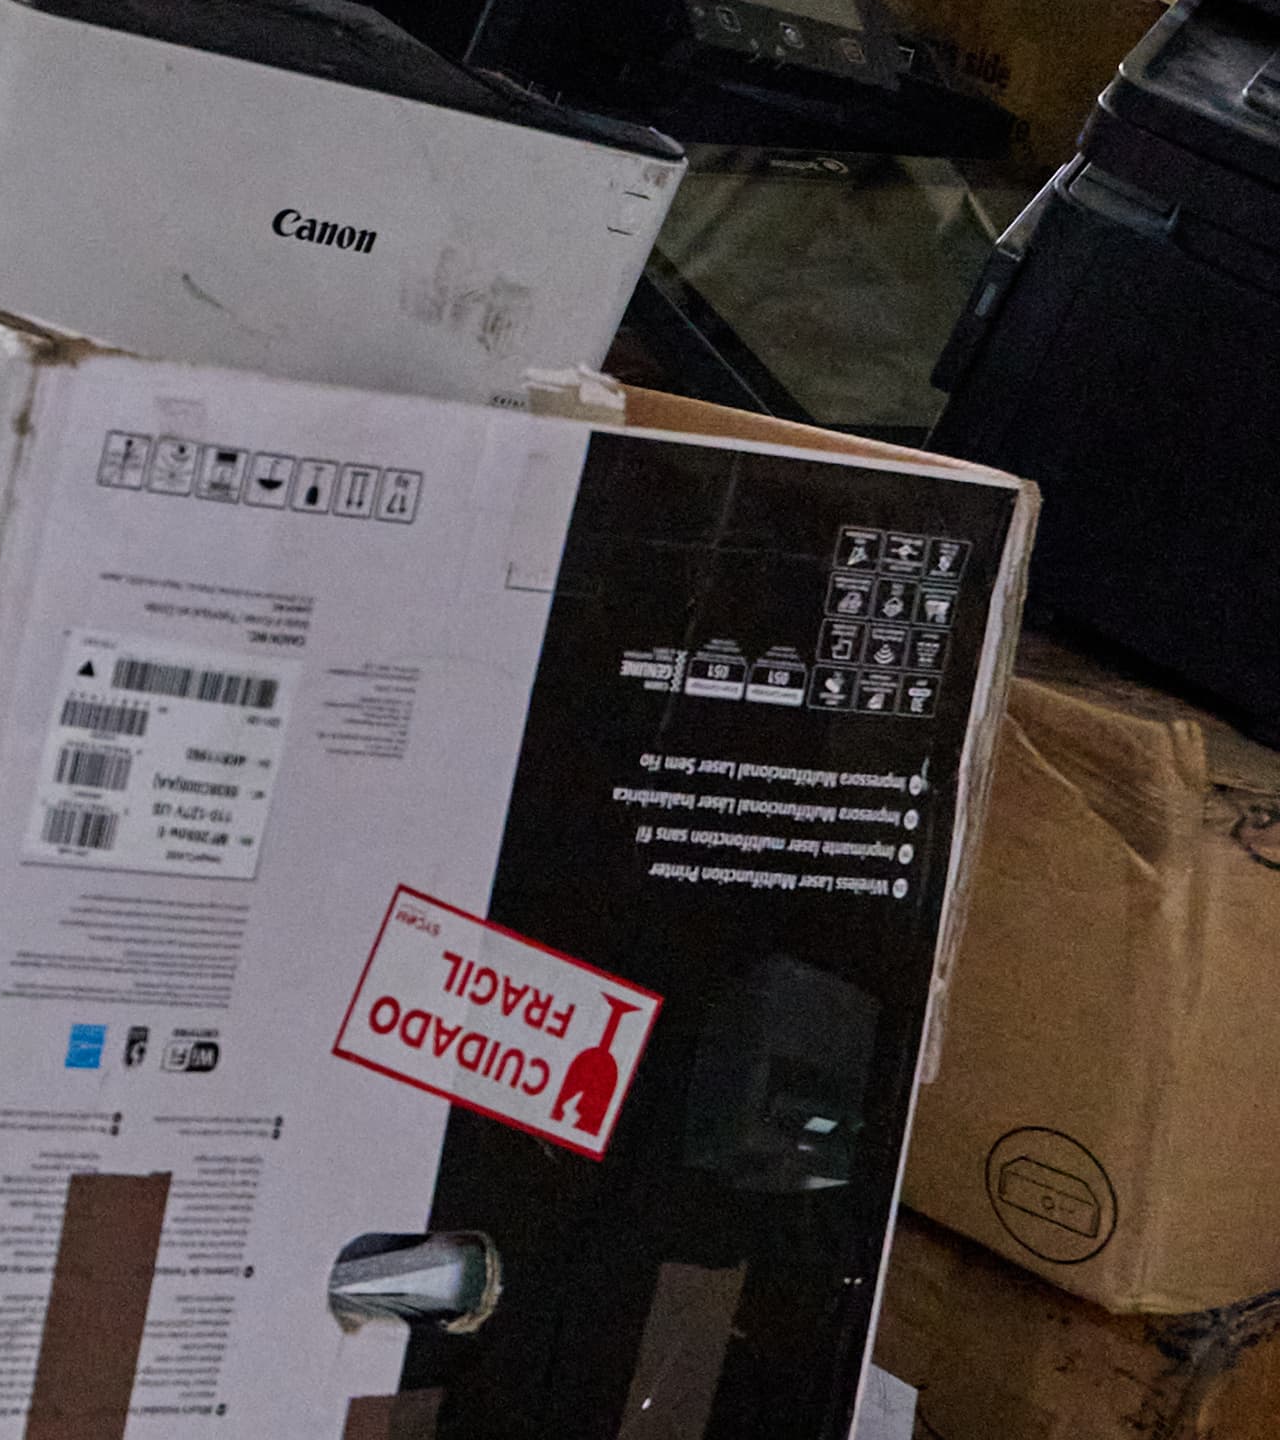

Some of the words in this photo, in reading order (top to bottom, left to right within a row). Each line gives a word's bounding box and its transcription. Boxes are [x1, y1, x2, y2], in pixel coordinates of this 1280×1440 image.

[271, 208, 378, 254] Canon
[639, 753, 662, 771] Fio
[665, 756, 696, 775] Sem
[697, 759, 735, 778] Laser
[737, 763, 837, 788] Multifuncional
[839, 772, 906, 792] Impressora
[737, 799, 837, 823] Multifuncional
[839, 807, 900, 826] Impresora
[656, 827, 688, 842] sans
[691, 828, 785, 852] multifonction
[787, 838, 819, 857] laser
[822, 840, 896, 861] Imprimante
[648, 861, 699, 881] Printer
[701, 867, 797, 890] Multifunction
[798, 873, 833, 892] Laser
[836, 875, 889, 895] Wireless
[442, 950, 576, 1039] FRAGIL
[368, 996, 551, 1096] CUIDADO
